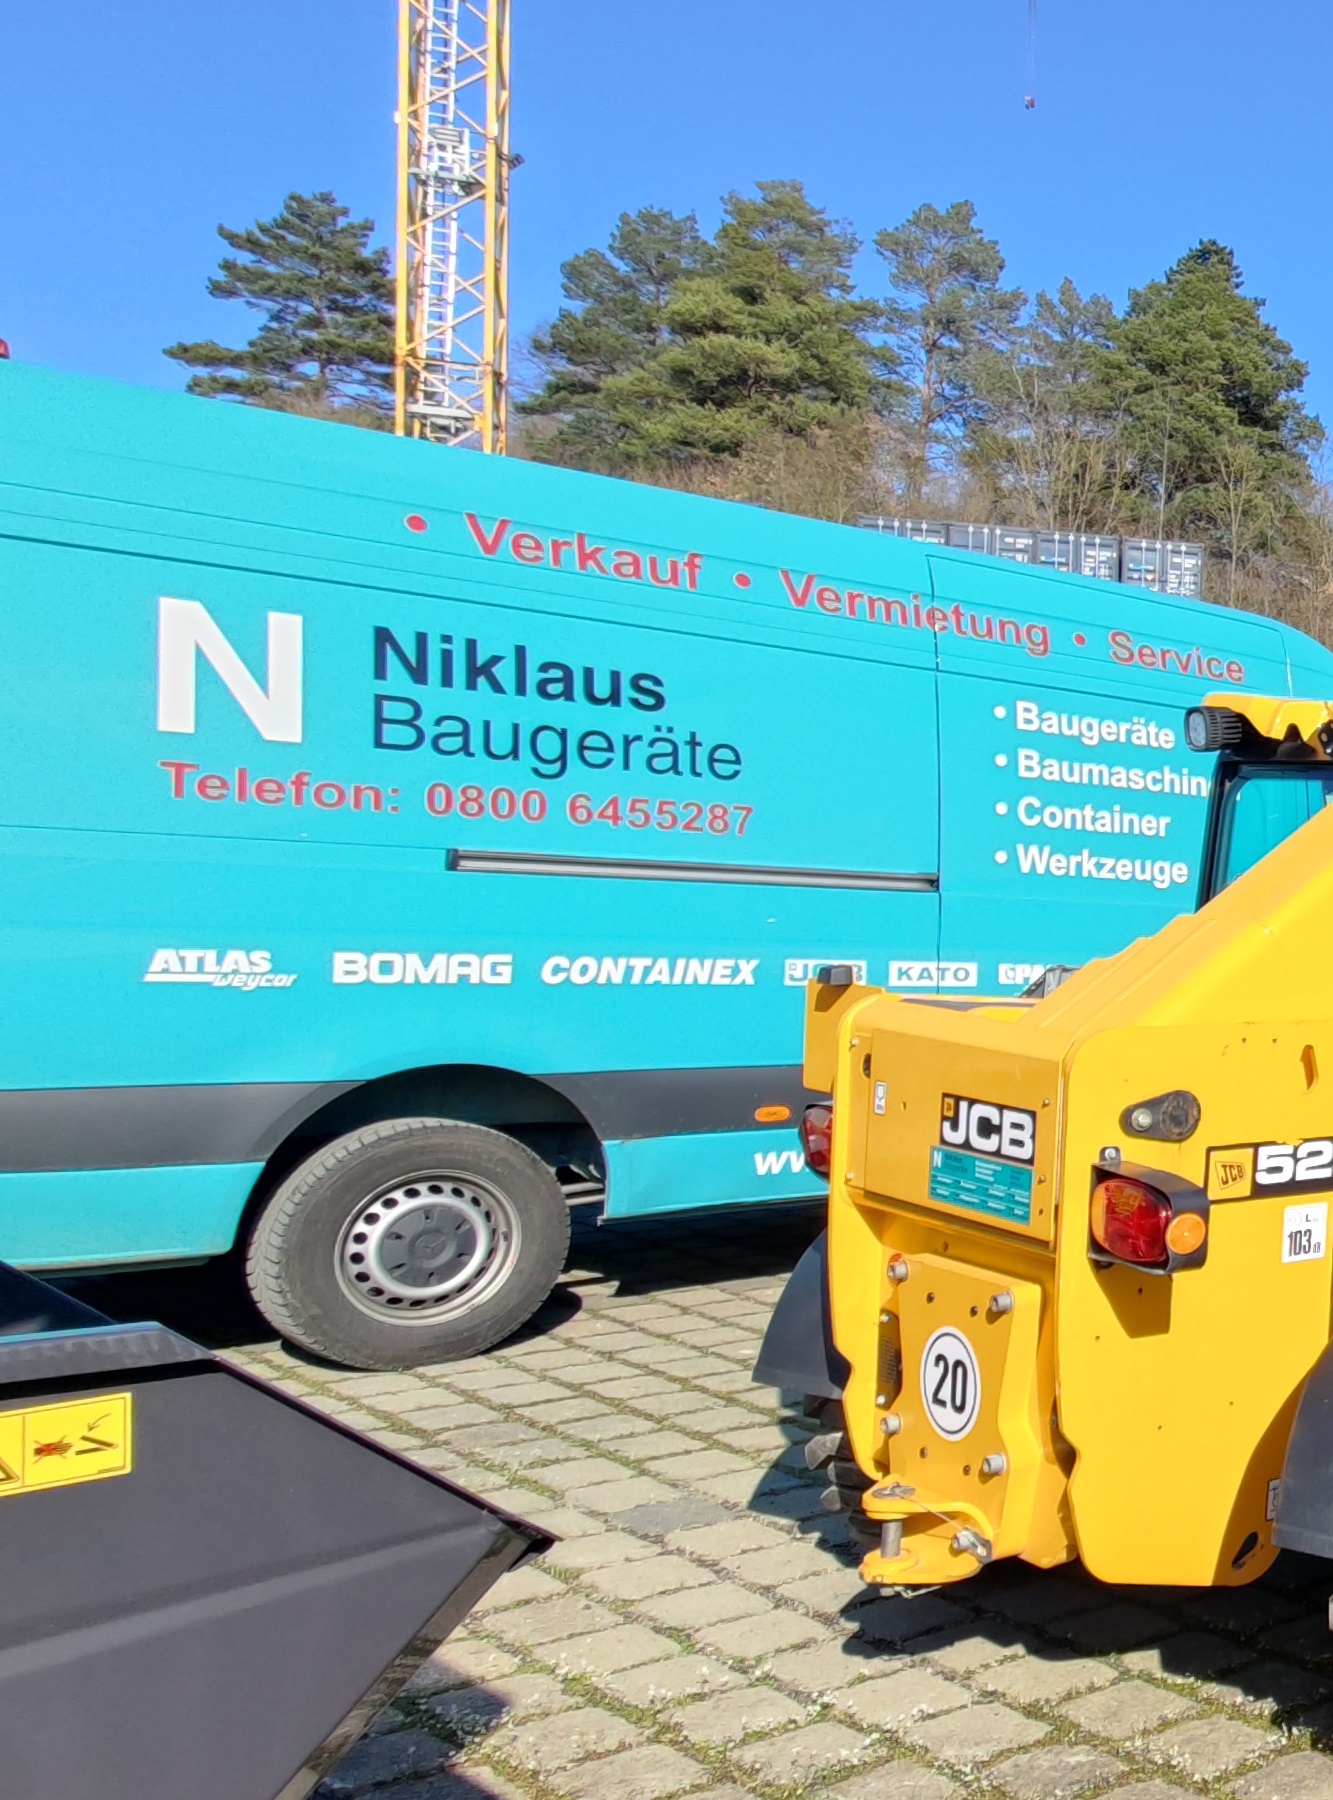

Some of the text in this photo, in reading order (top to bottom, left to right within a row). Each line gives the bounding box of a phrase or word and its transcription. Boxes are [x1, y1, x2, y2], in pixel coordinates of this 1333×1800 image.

[463, 512, 1244, 683] Verkauf Vermietung Service
[156, 596, 303, 743] N
[373, 626, 666, 711] Niklaus
[373, 694, 742, 781] Baugeräte
[1016, 700, 1176, 750] Baugeräte
[1017, 748, 1211, 797] Baumaschin
[158, 759, 754, 836] Telefon: 0800 6455287
[1017, 796, 1171, 837] Container
[1016, 844, 1188, 889] Werkzeuge
[148, 949, 272, 973] ATLAS
[212, 972, 297, 991] weycor
[332, 951, 513, 986] BOMAG
[540, 956, 761, 987] CONTAINEX
[896, 966, 971, 983] KATO
[942, 1100, 1034, 1160] JCB
[1219, 1163, 1246, 1187] JCB
[1288, 1229, 1312, 1257] 103
[931, 1353, 968, 1415] 20
